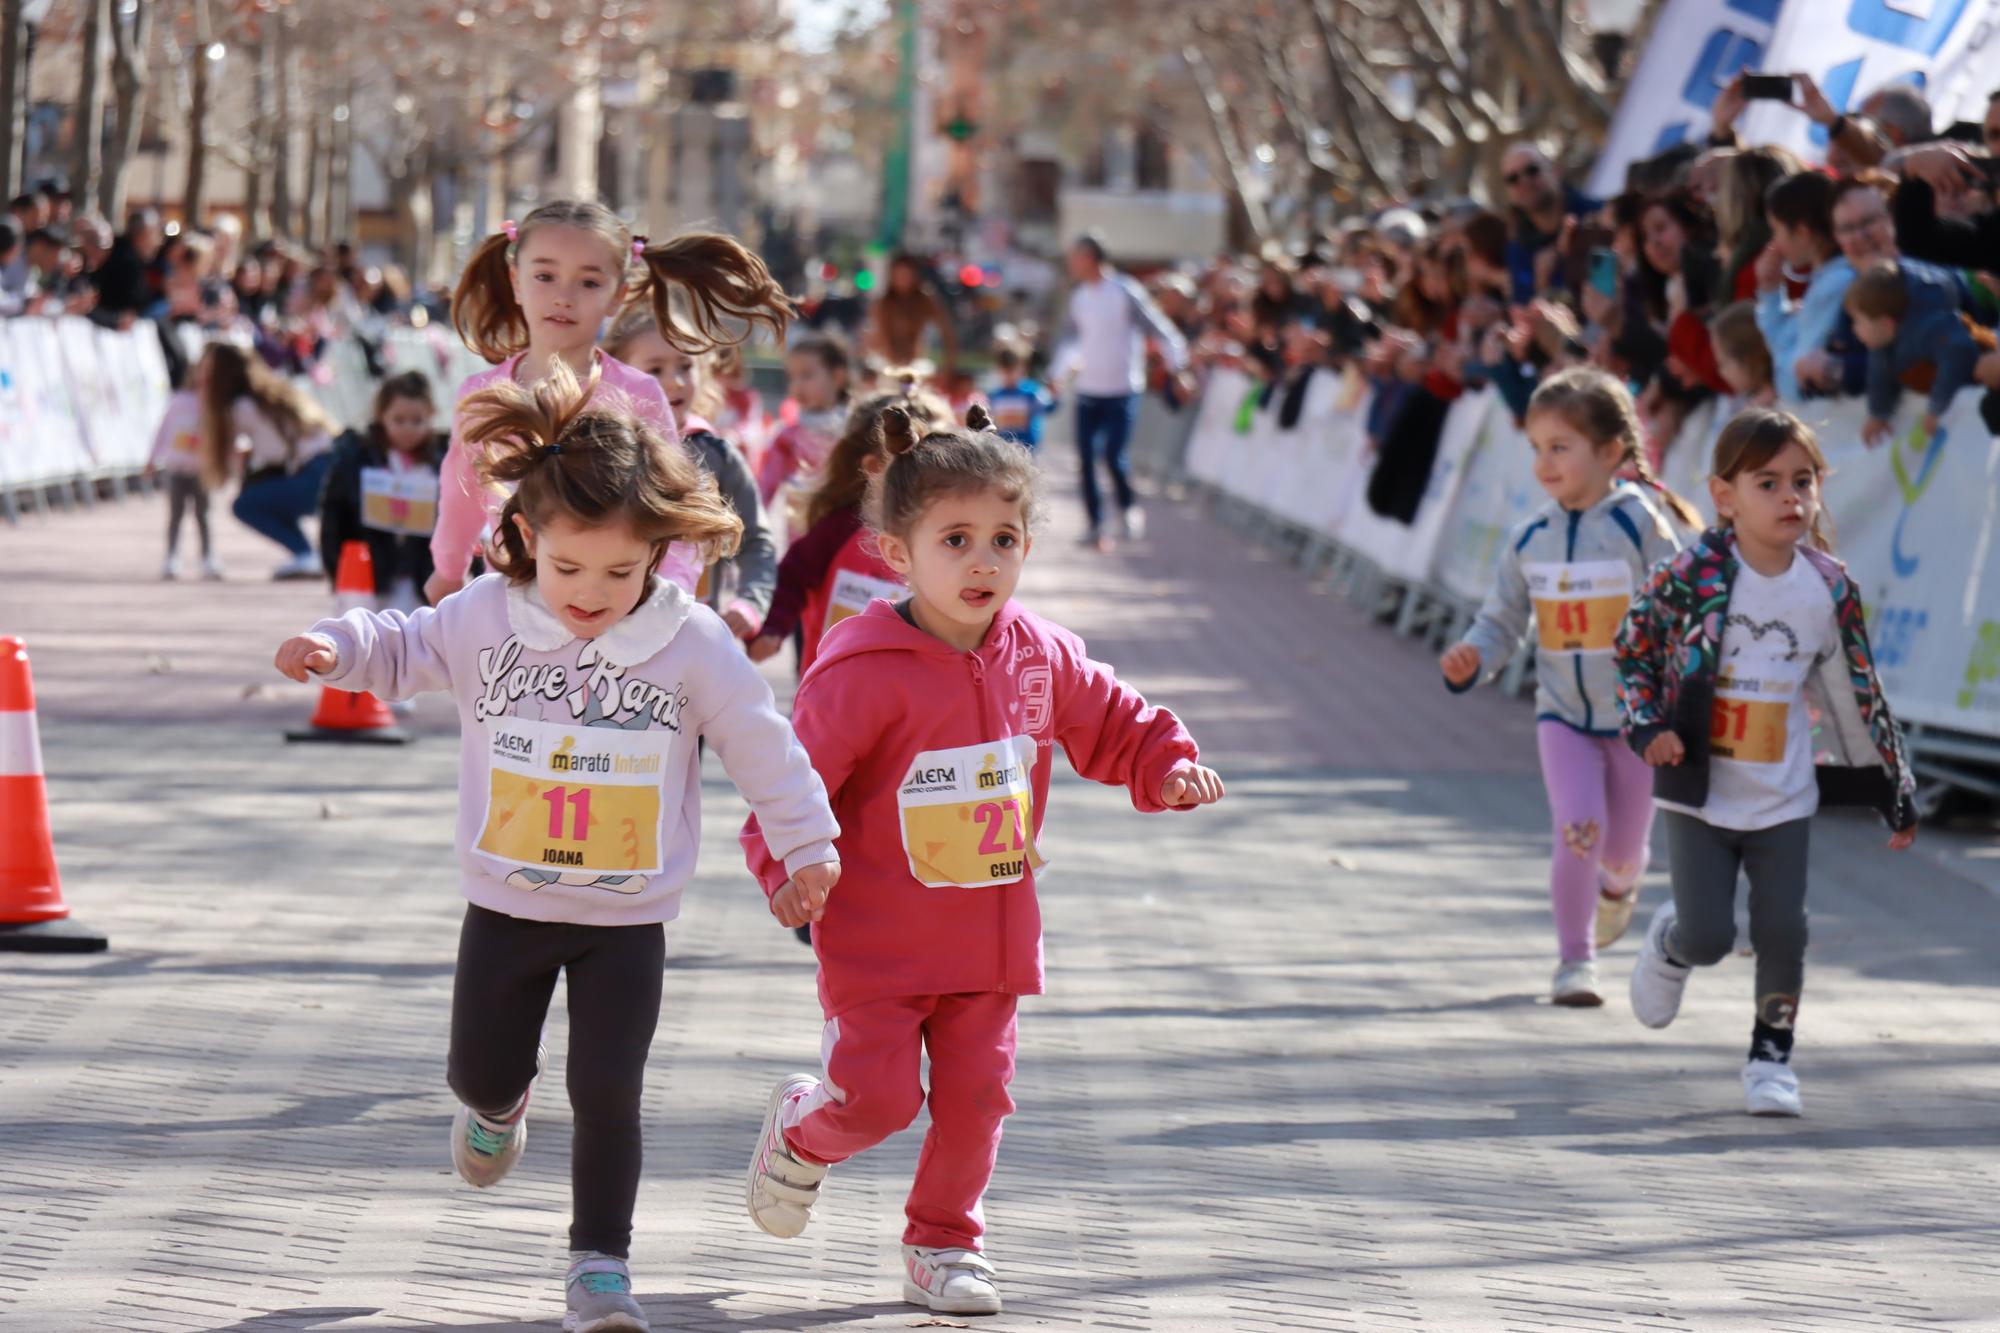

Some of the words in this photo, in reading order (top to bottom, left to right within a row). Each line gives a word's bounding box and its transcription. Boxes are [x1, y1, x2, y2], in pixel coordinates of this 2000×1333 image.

[1556, 600, 1589, 637] 41
[475, 634, 568, 722] Love
[542, 786, 591, 841] 11
[974, 799, 1024, 856] 27
[542, 848, 584, 866] JOANA
